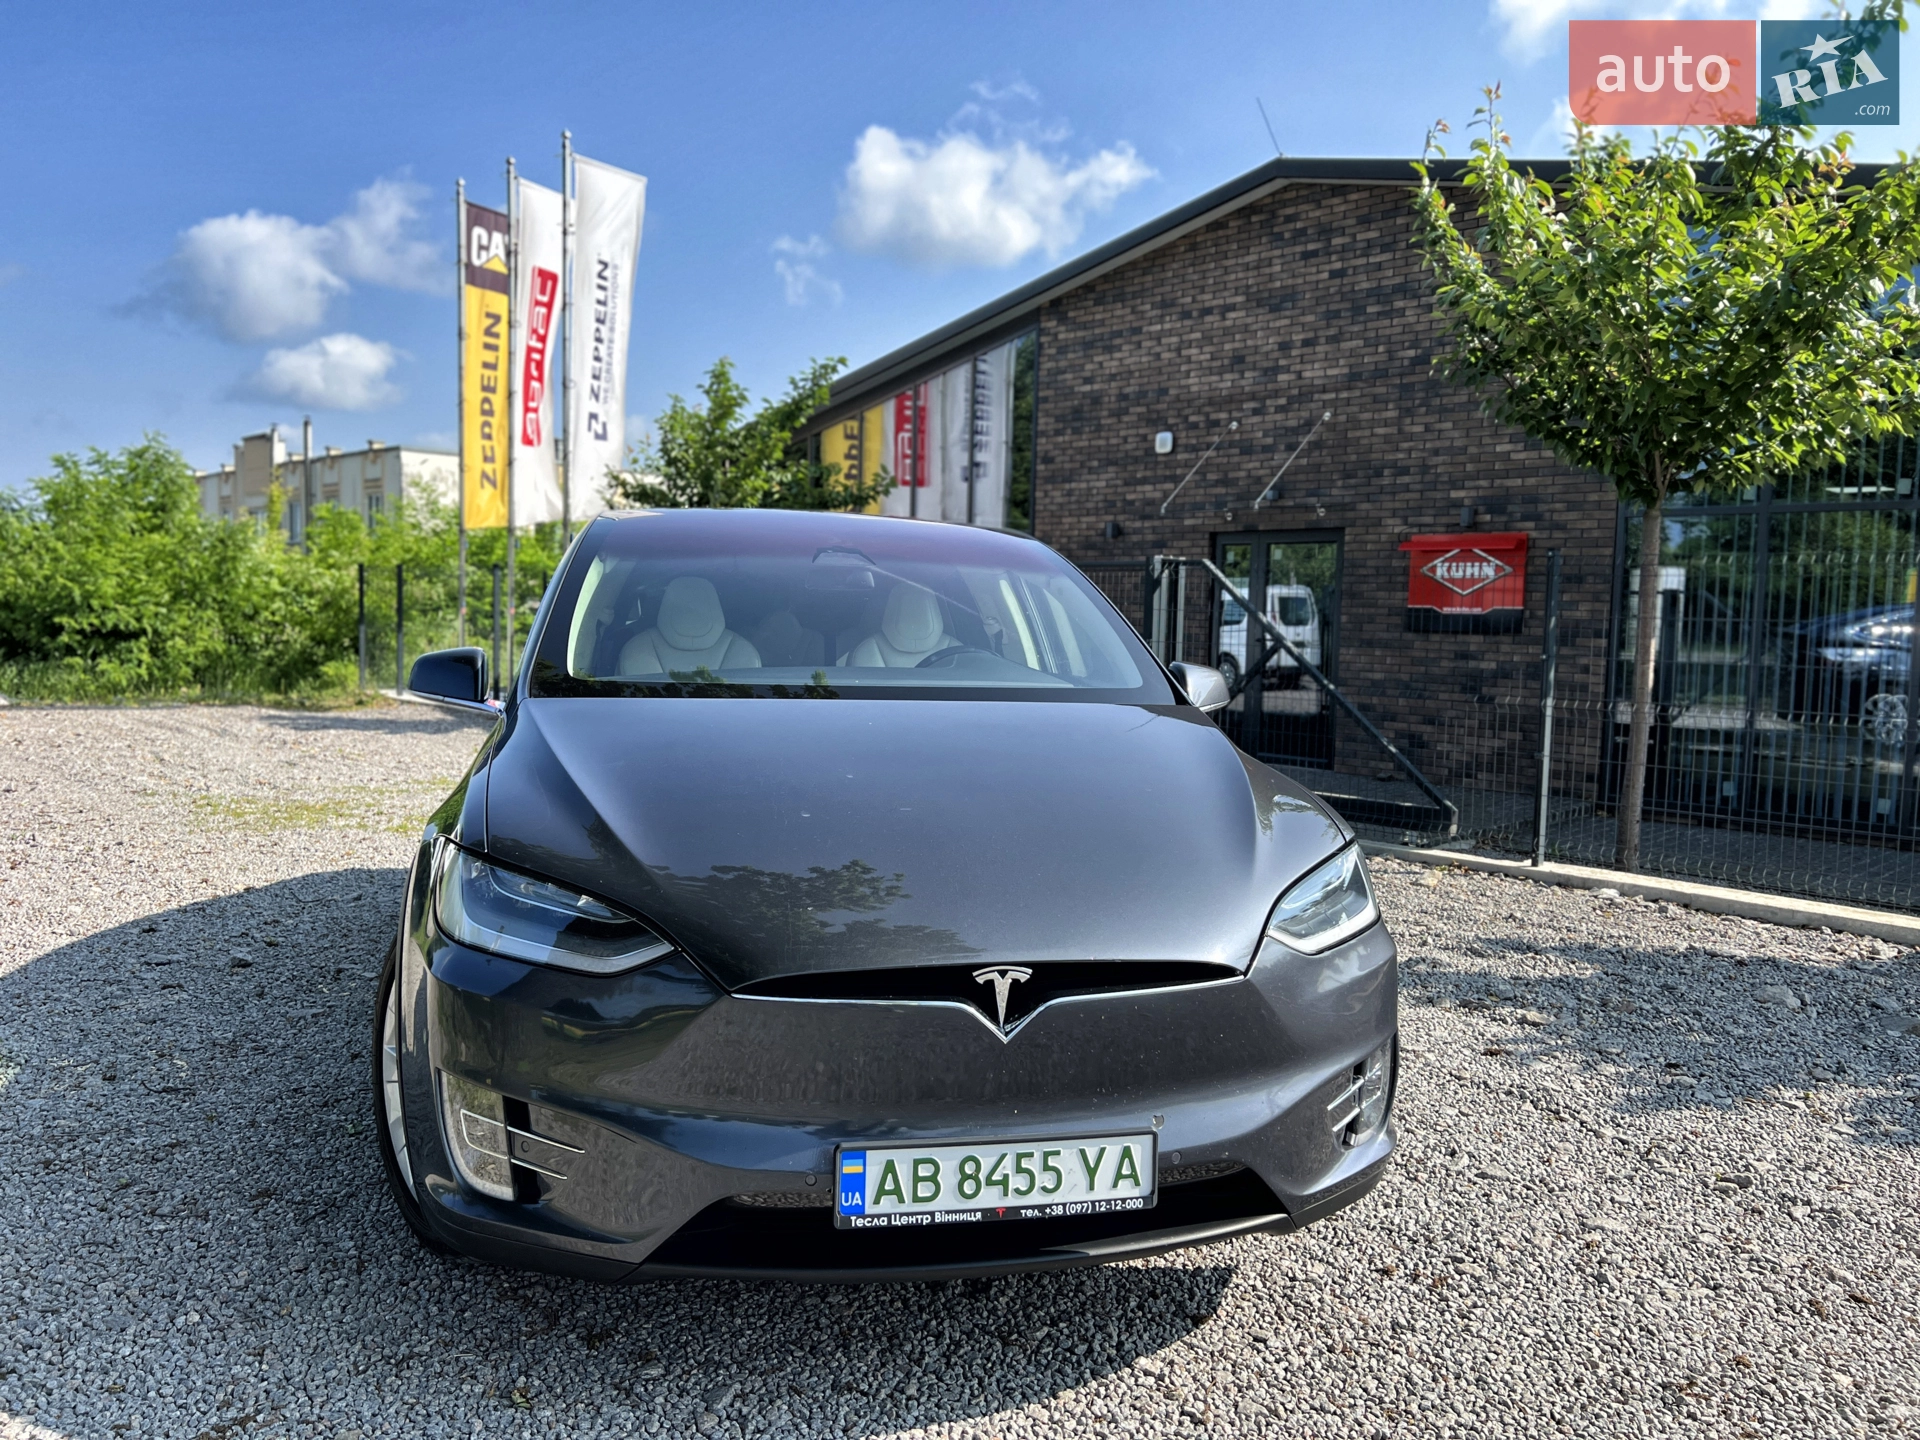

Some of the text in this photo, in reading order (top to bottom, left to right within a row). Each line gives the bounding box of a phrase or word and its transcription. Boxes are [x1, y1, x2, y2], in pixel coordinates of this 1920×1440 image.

[471, 225, 509, 267] CA
[589, 258, 609, 403] ZEPPELIN
[480, 311, 501, 491] ZEPPELIN
[1435, 562, 1496, 579] KUHN
[873, 1145, 1141, 1205] AB 8455 YA
[841, 1191, 862, 1206] UA
[1020, 1198, 1143, 1218] тел. +38 (097) 12-12-000
[850, 1210, 982, 1228] Тесла Центр Вінниця
